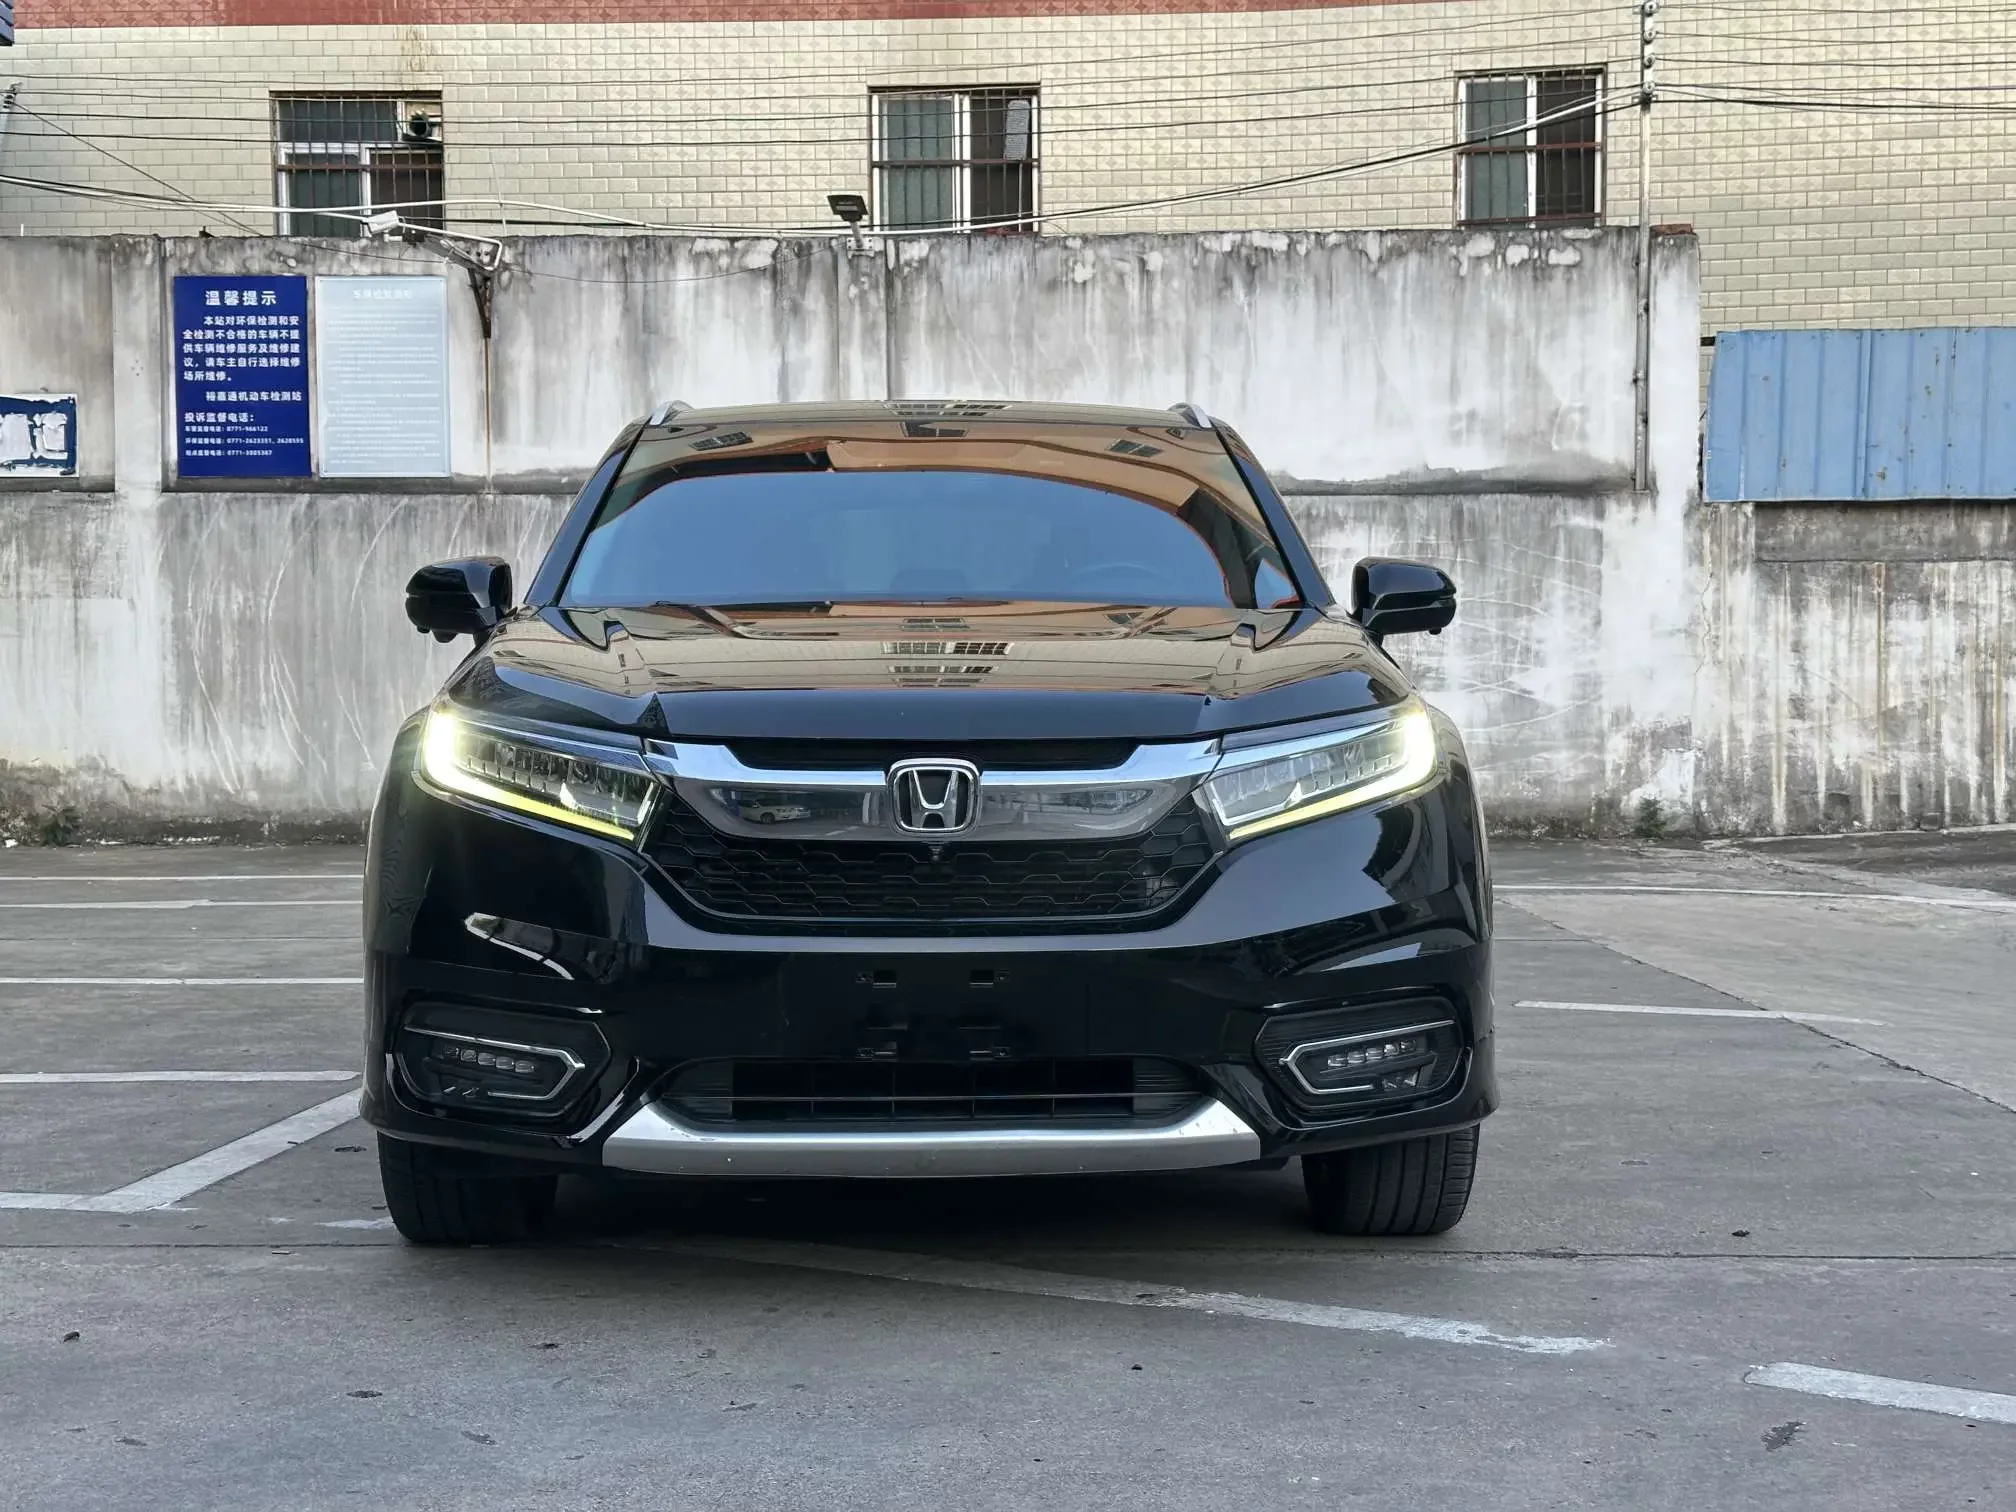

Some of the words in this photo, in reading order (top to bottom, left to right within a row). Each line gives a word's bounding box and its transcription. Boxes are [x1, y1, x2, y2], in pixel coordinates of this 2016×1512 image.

[205, 290, 276, 306] 温馨提示
[203, 315, 300, 326] 本站对环保检测和安
[182, 329, 300, 340] 全检测不合格的车辆不提
